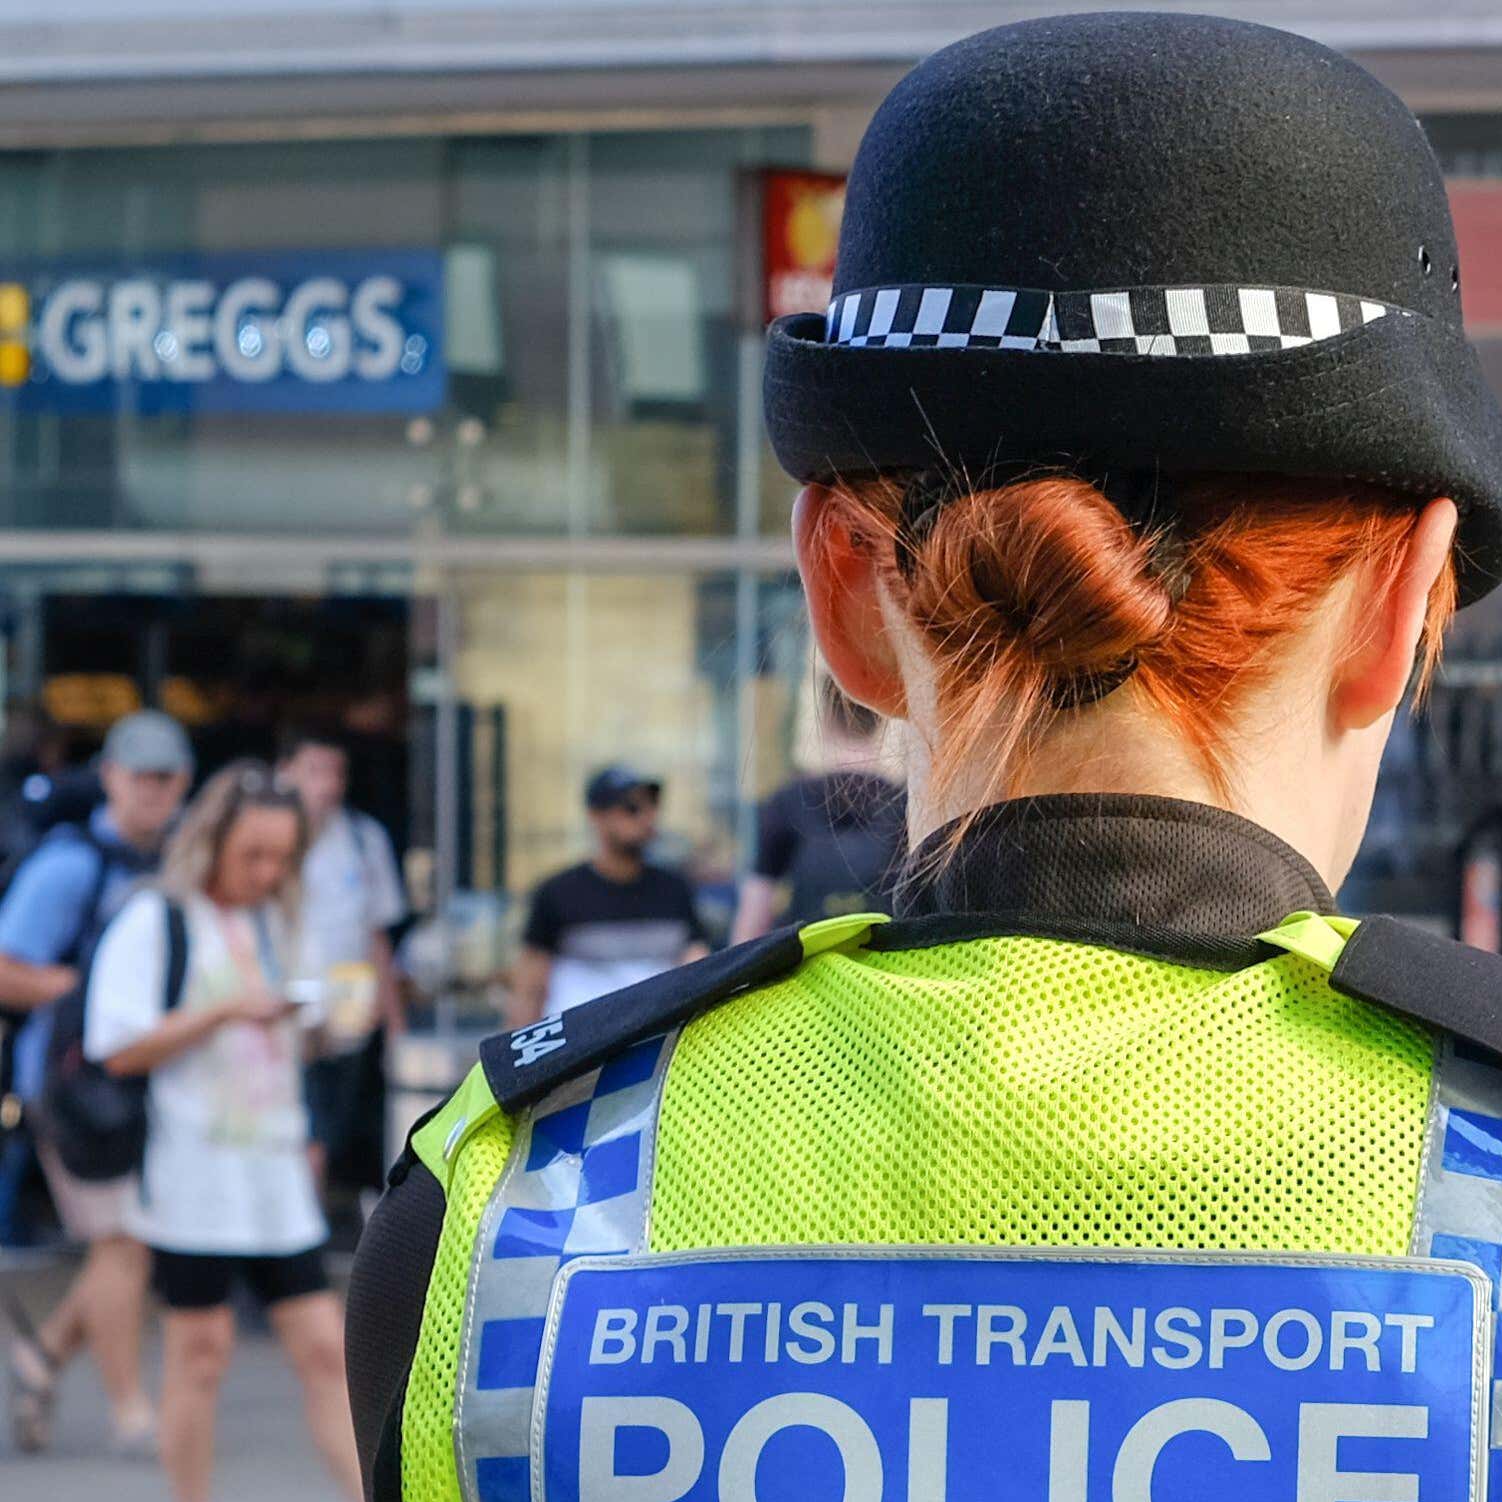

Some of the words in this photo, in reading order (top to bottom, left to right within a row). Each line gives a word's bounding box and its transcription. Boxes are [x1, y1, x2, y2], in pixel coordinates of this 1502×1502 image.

[38, 276, 404, 385] GREGGS
[588, 1301, 893, 1366] BRITISH
[921, 1303, 1436, 1373] TRANSPORT
